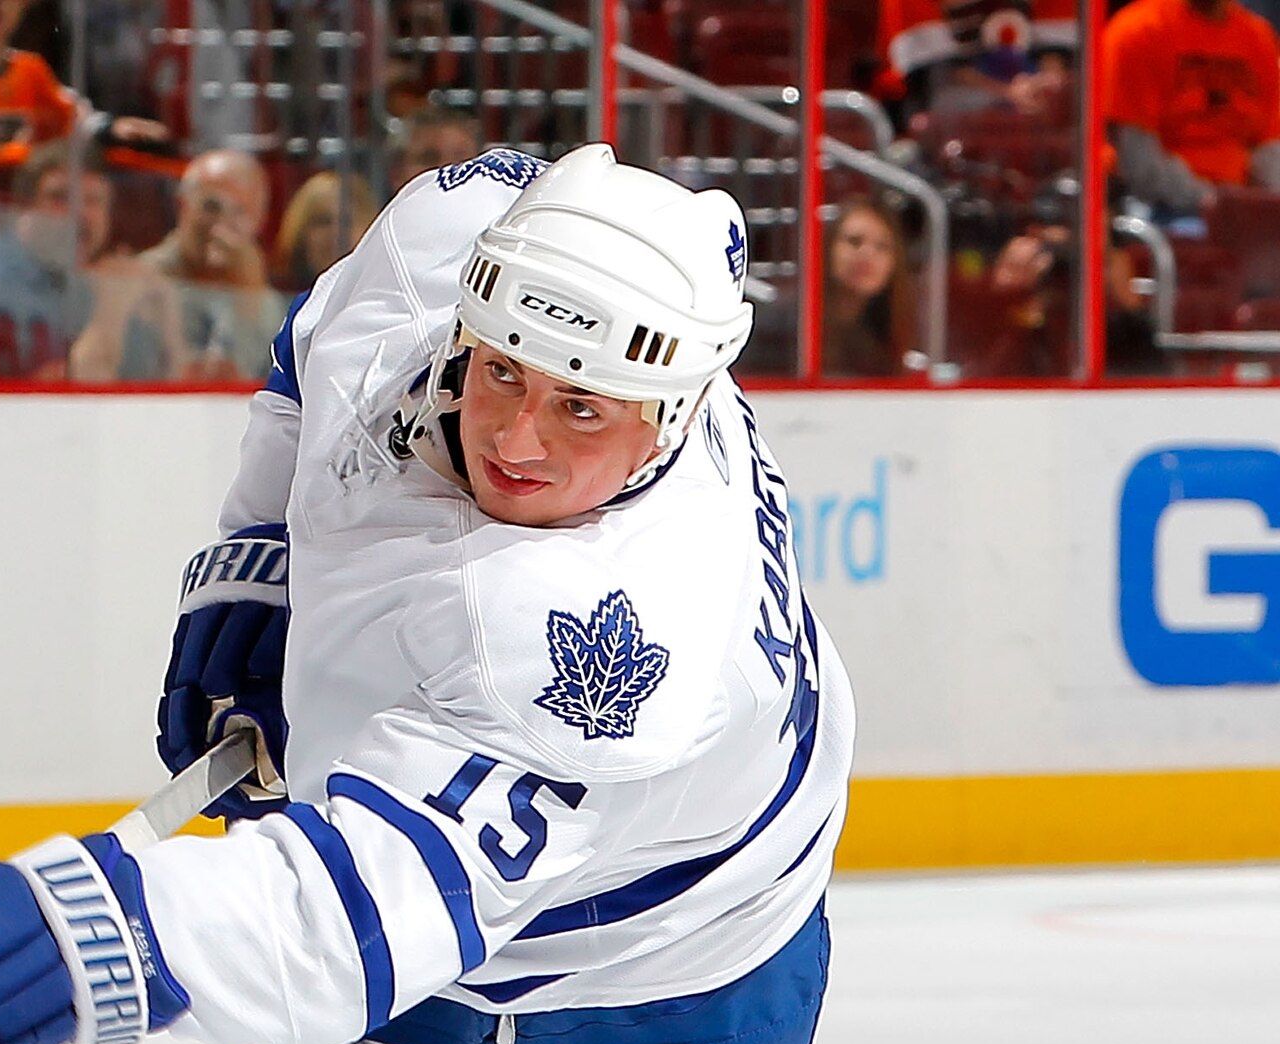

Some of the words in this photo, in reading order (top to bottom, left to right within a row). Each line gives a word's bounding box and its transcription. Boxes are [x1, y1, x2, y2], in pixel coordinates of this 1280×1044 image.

[519, 292, 599, 331] CCM
[1116, 443, 1280, 688] G
[422, 752, 588, 882] 15
